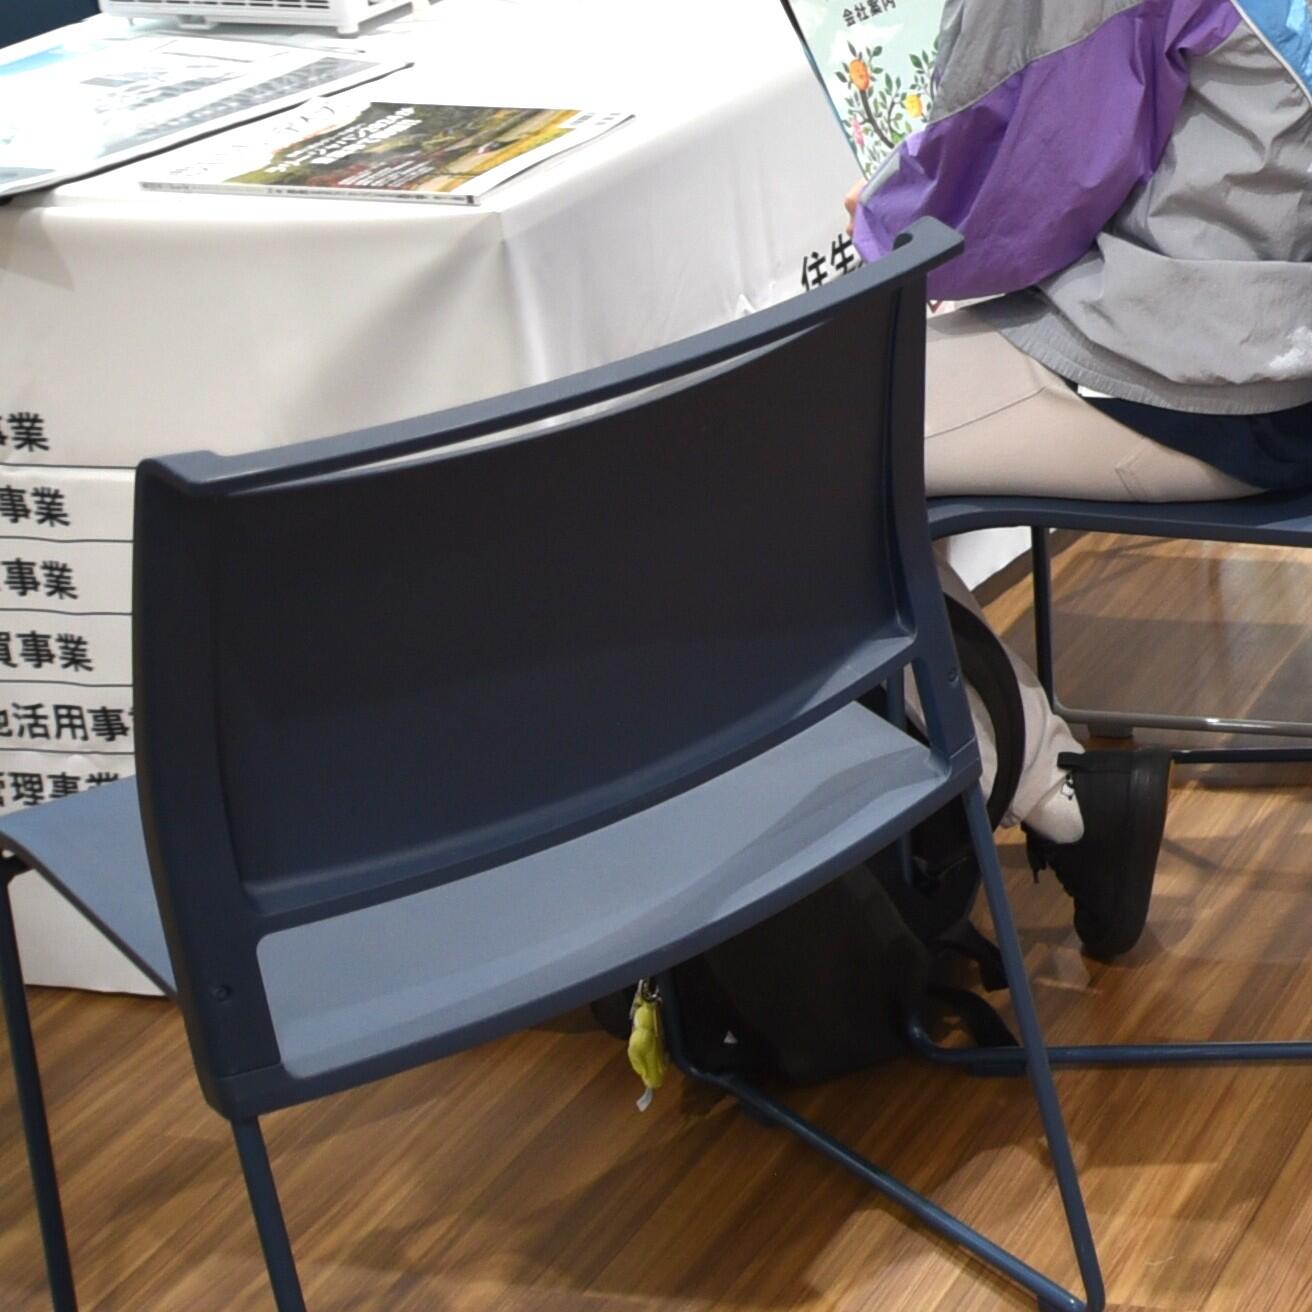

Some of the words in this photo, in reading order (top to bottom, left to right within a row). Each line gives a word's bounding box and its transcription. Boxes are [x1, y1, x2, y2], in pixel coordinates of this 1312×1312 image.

[0, 411, 50, 453] 業
[0, 485, 71, 528] 事業
[2, 557, 79, 601] 事業
[0, 701, 135, 743] 活用事
